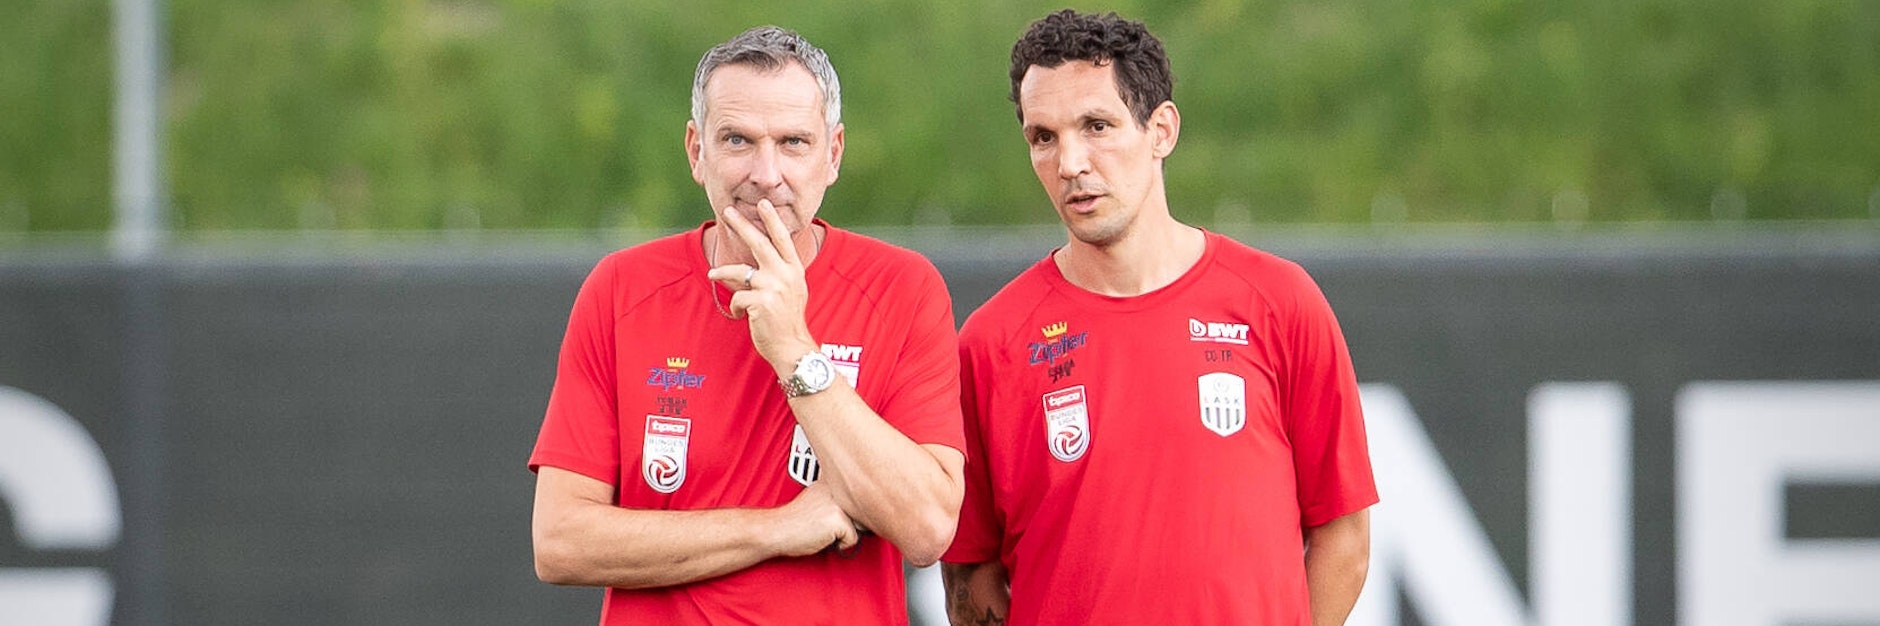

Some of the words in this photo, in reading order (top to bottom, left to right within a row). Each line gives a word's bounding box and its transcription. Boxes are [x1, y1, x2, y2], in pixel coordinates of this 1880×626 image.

[1206, 321, 1250, 340] BWT
[1027, 331, 1087, 365] Zipfer
[646, 367, 705, 391] Zipfer
[1204, 396, 1240, 405] LASK
[795, 443, 813, 455] LA
